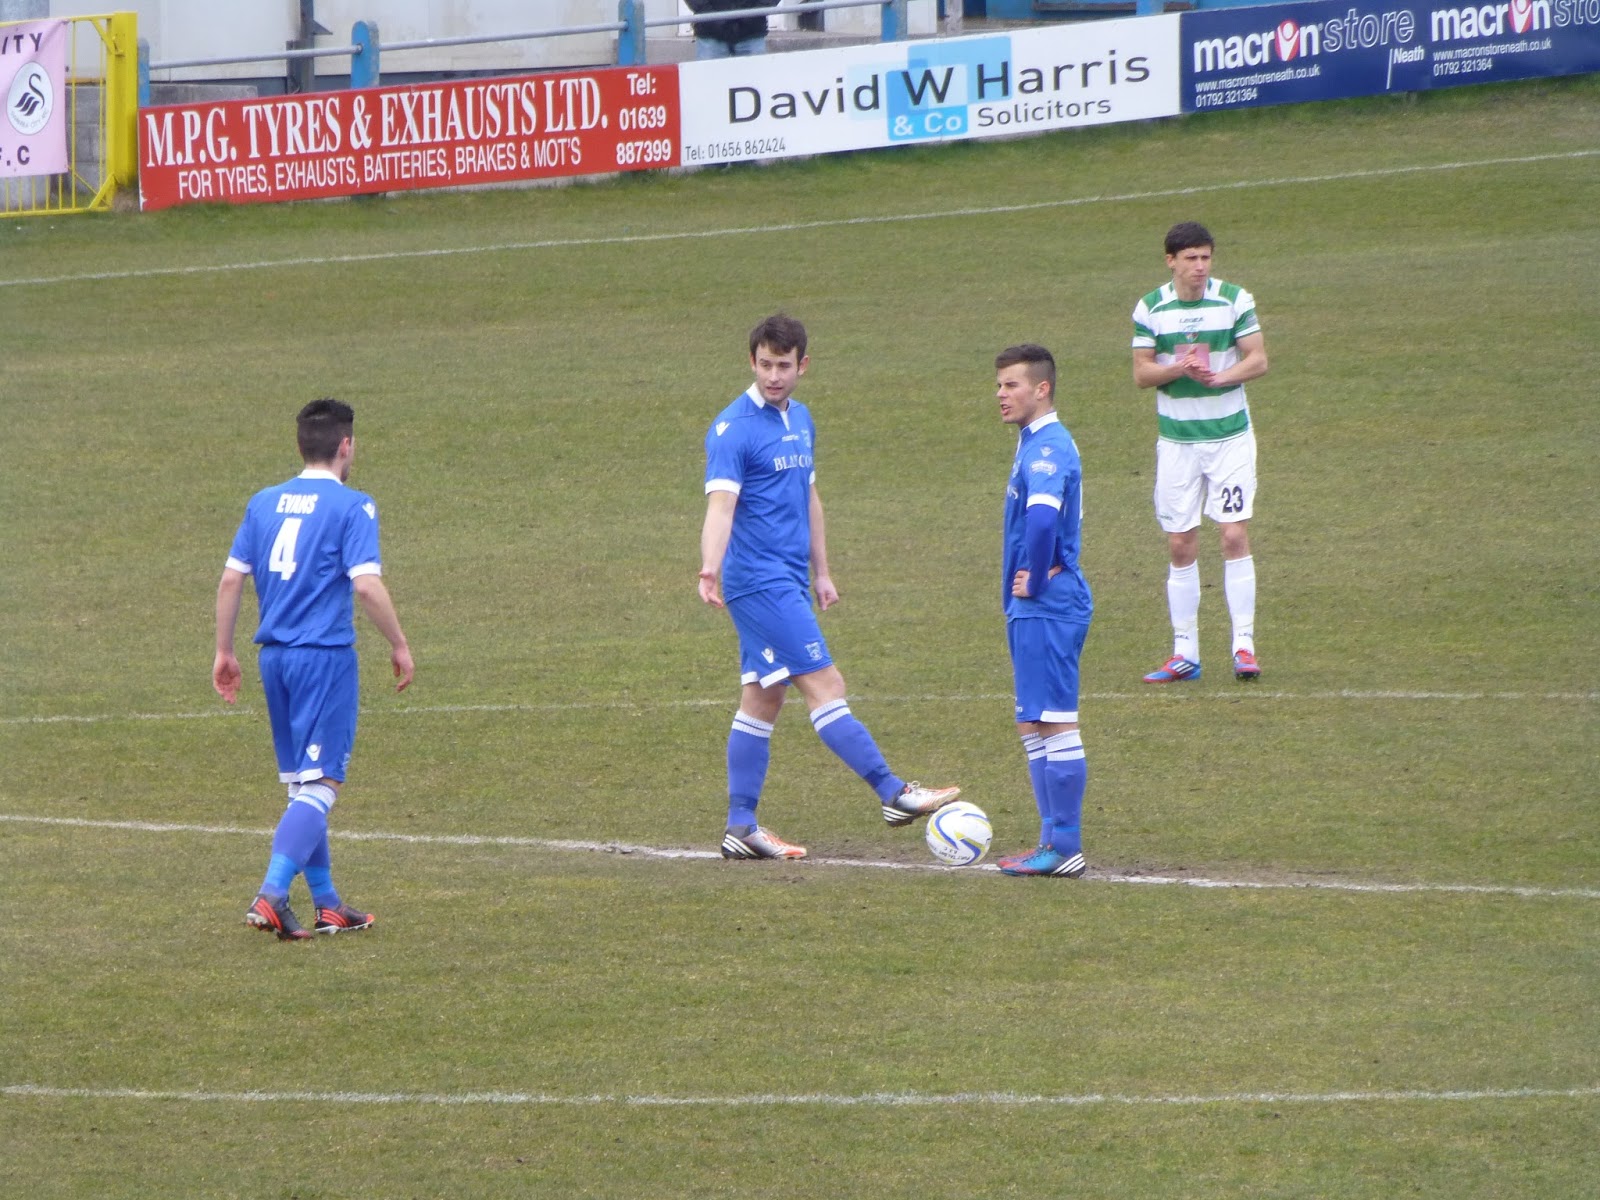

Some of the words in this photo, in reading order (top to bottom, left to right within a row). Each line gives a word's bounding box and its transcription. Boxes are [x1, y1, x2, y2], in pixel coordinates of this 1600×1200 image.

[1393, 45, 1425, 65] Neath
[1433, 37, 1552, 62] www.macronstoreneath.co.uk
[1195, 64, 1320, 93] www.macronstoreneath.co.uk
[1433, 62, 1460, 77] 01792
[1461, 58, 1493, 74] 321364
[627, 73, 656, 96] Tel:
[728, 74, 880, 124] David
[901, 66, 954, 106] W
[976, 49, 1150, 99] Harris
[1196, 92, 1223, 108] 01792
[1225, 88, 1258, 104] 321364
[146, 107, 238, 168] M.P.G.
[243, 97, 341, 159] TYRES
[350, 95, 373, 150] &
[380, 81, 537, 147] EXHAUSTS
[543, 76, 608, 133] LTD.
[619, 105, 667, 131] 01639
[893, 114, 913, 136] &
[924, 112, 961, 132] Co
[977, 99, 1112, 128] Solicitors
[616, 138, 672, 165] 887399
[685, 145, 705, 161] Tel:
[708, 141, 742, 159] 01656
[745, 137, 786, 157] 862424
[178, 170, 213, 199] FOR
[215, 164, 272, 196] TYRES,
[275, 156, 360, 188] EXHAUSTS,
[364, 147, 451, 182] BATTERIES,
[455, 141, 516, 175] BRAKES
[521, 141, 531, 169] &
[533, 136, 581, 168] MOT'S
[276, 493, 319, 514] EVANS
[1221, 486, 1244, 513] 23
[268, 517, 302, 580] 4
